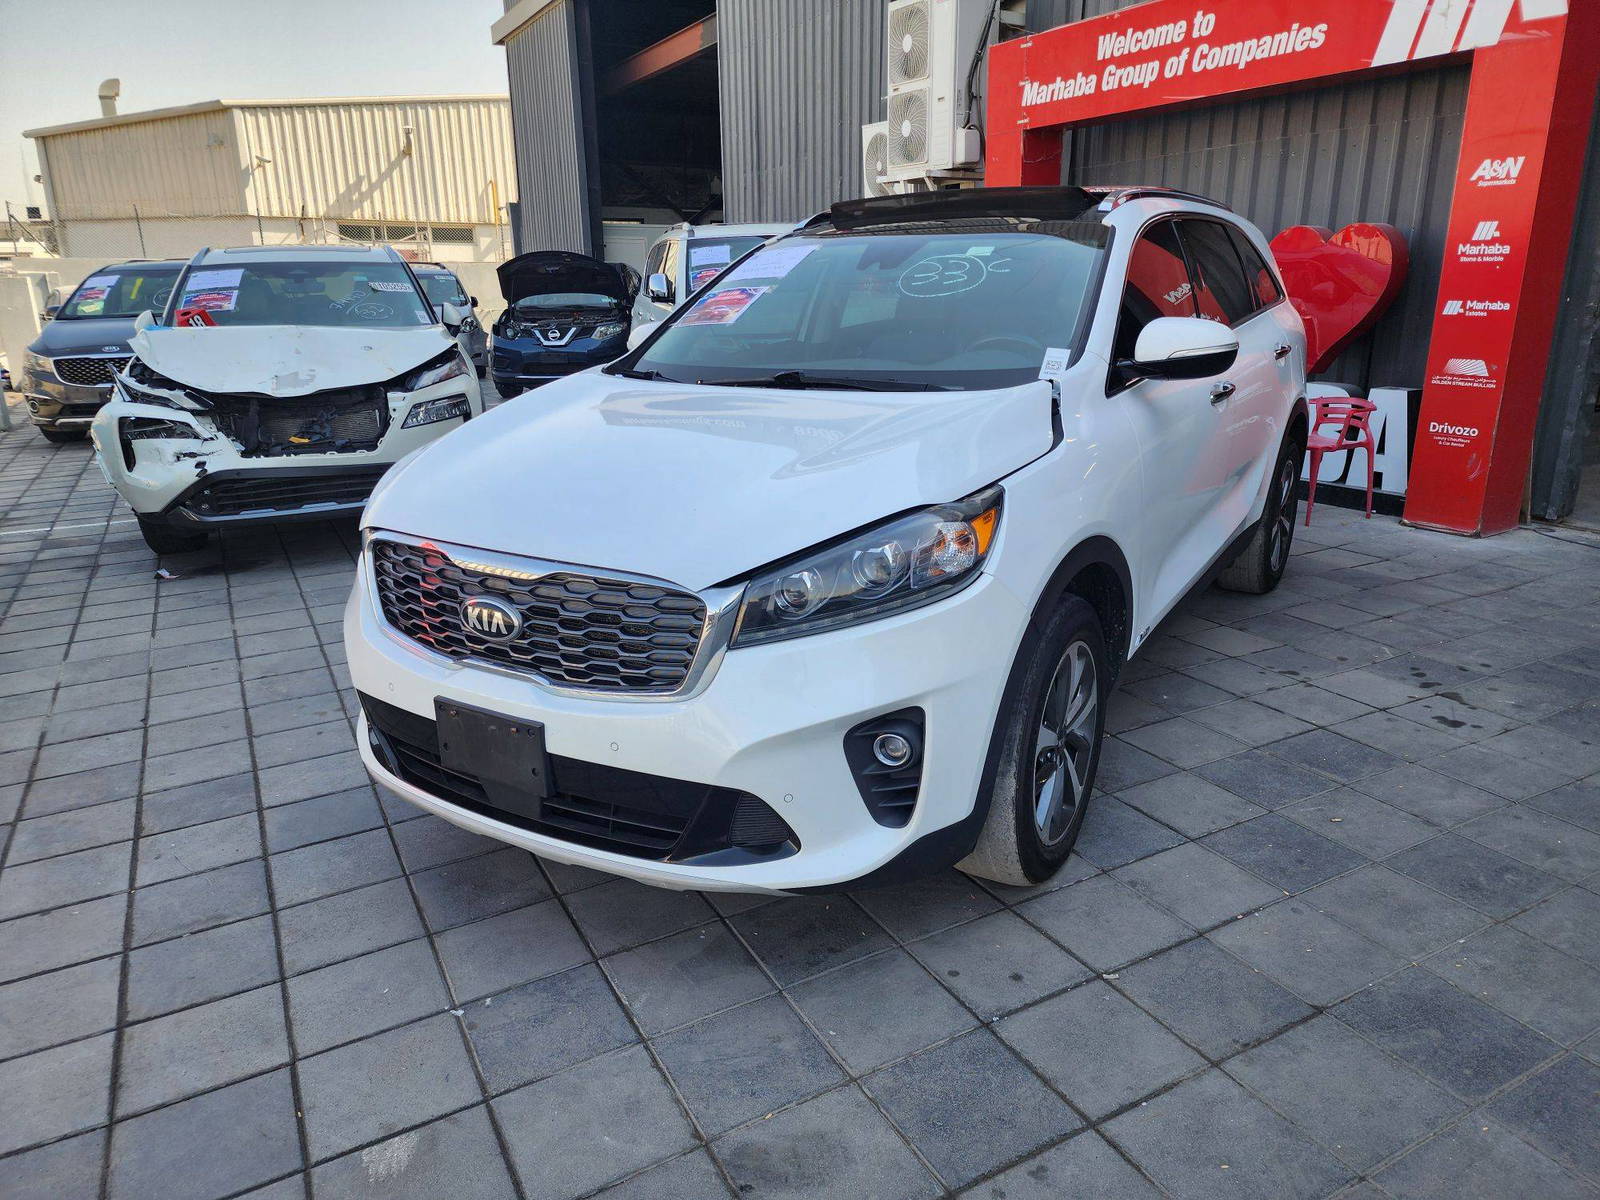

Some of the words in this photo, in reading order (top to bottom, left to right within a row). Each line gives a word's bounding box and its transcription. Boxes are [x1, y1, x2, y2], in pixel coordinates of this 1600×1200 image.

[1096, 20, 1187, 61] Welcome
[1192, 10, 1216, 39] to
[1021, 71, 1097, 107] Marhaba
[1101, 60, 1160, 92] Group
[1164, 47, 1190, 79] of
[1192, 23, 1328, 73] Companies
[1469, 156, 1526, 181] A&N
[1457, 243, 1511, 255] Marhaba
[1466, 300, 1511, 311] Marhaba
[1429, 422, 1479, 437] Drivozo
[467, 605, 508, 635] KIA
